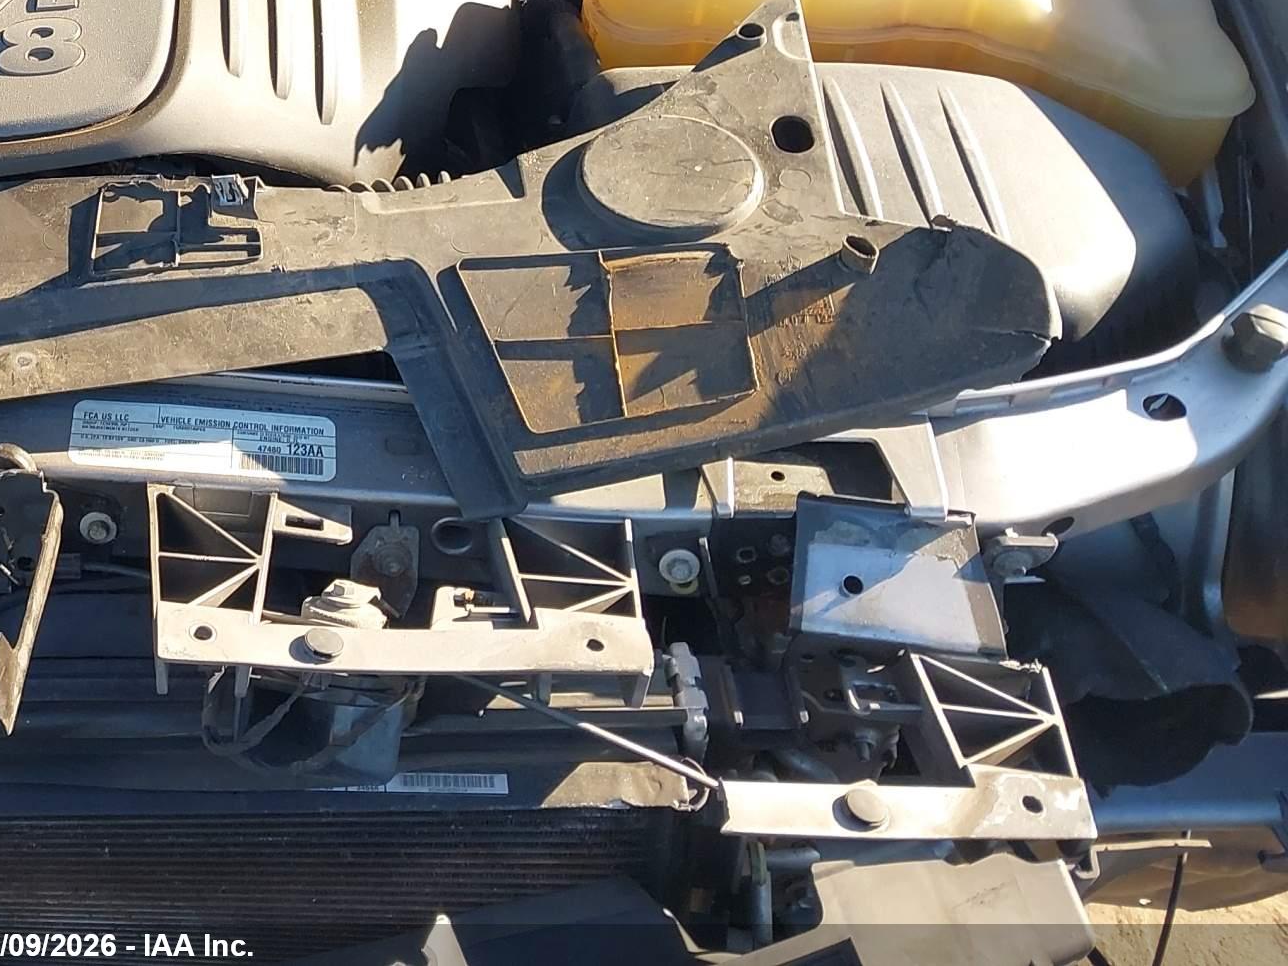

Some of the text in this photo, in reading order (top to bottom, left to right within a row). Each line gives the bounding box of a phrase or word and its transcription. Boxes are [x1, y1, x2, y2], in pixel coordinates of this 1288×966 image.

[83, 411, 130, 422] FCA US LLC
[161, 416, 192, 427] VEHICLE
[194, 418, 231, 428] EMISSION
[233, 420, 267, 432] CONTROL
[270, 423, 324, 435] INFORMATION
[286, 443, 324, 457] 123AA
